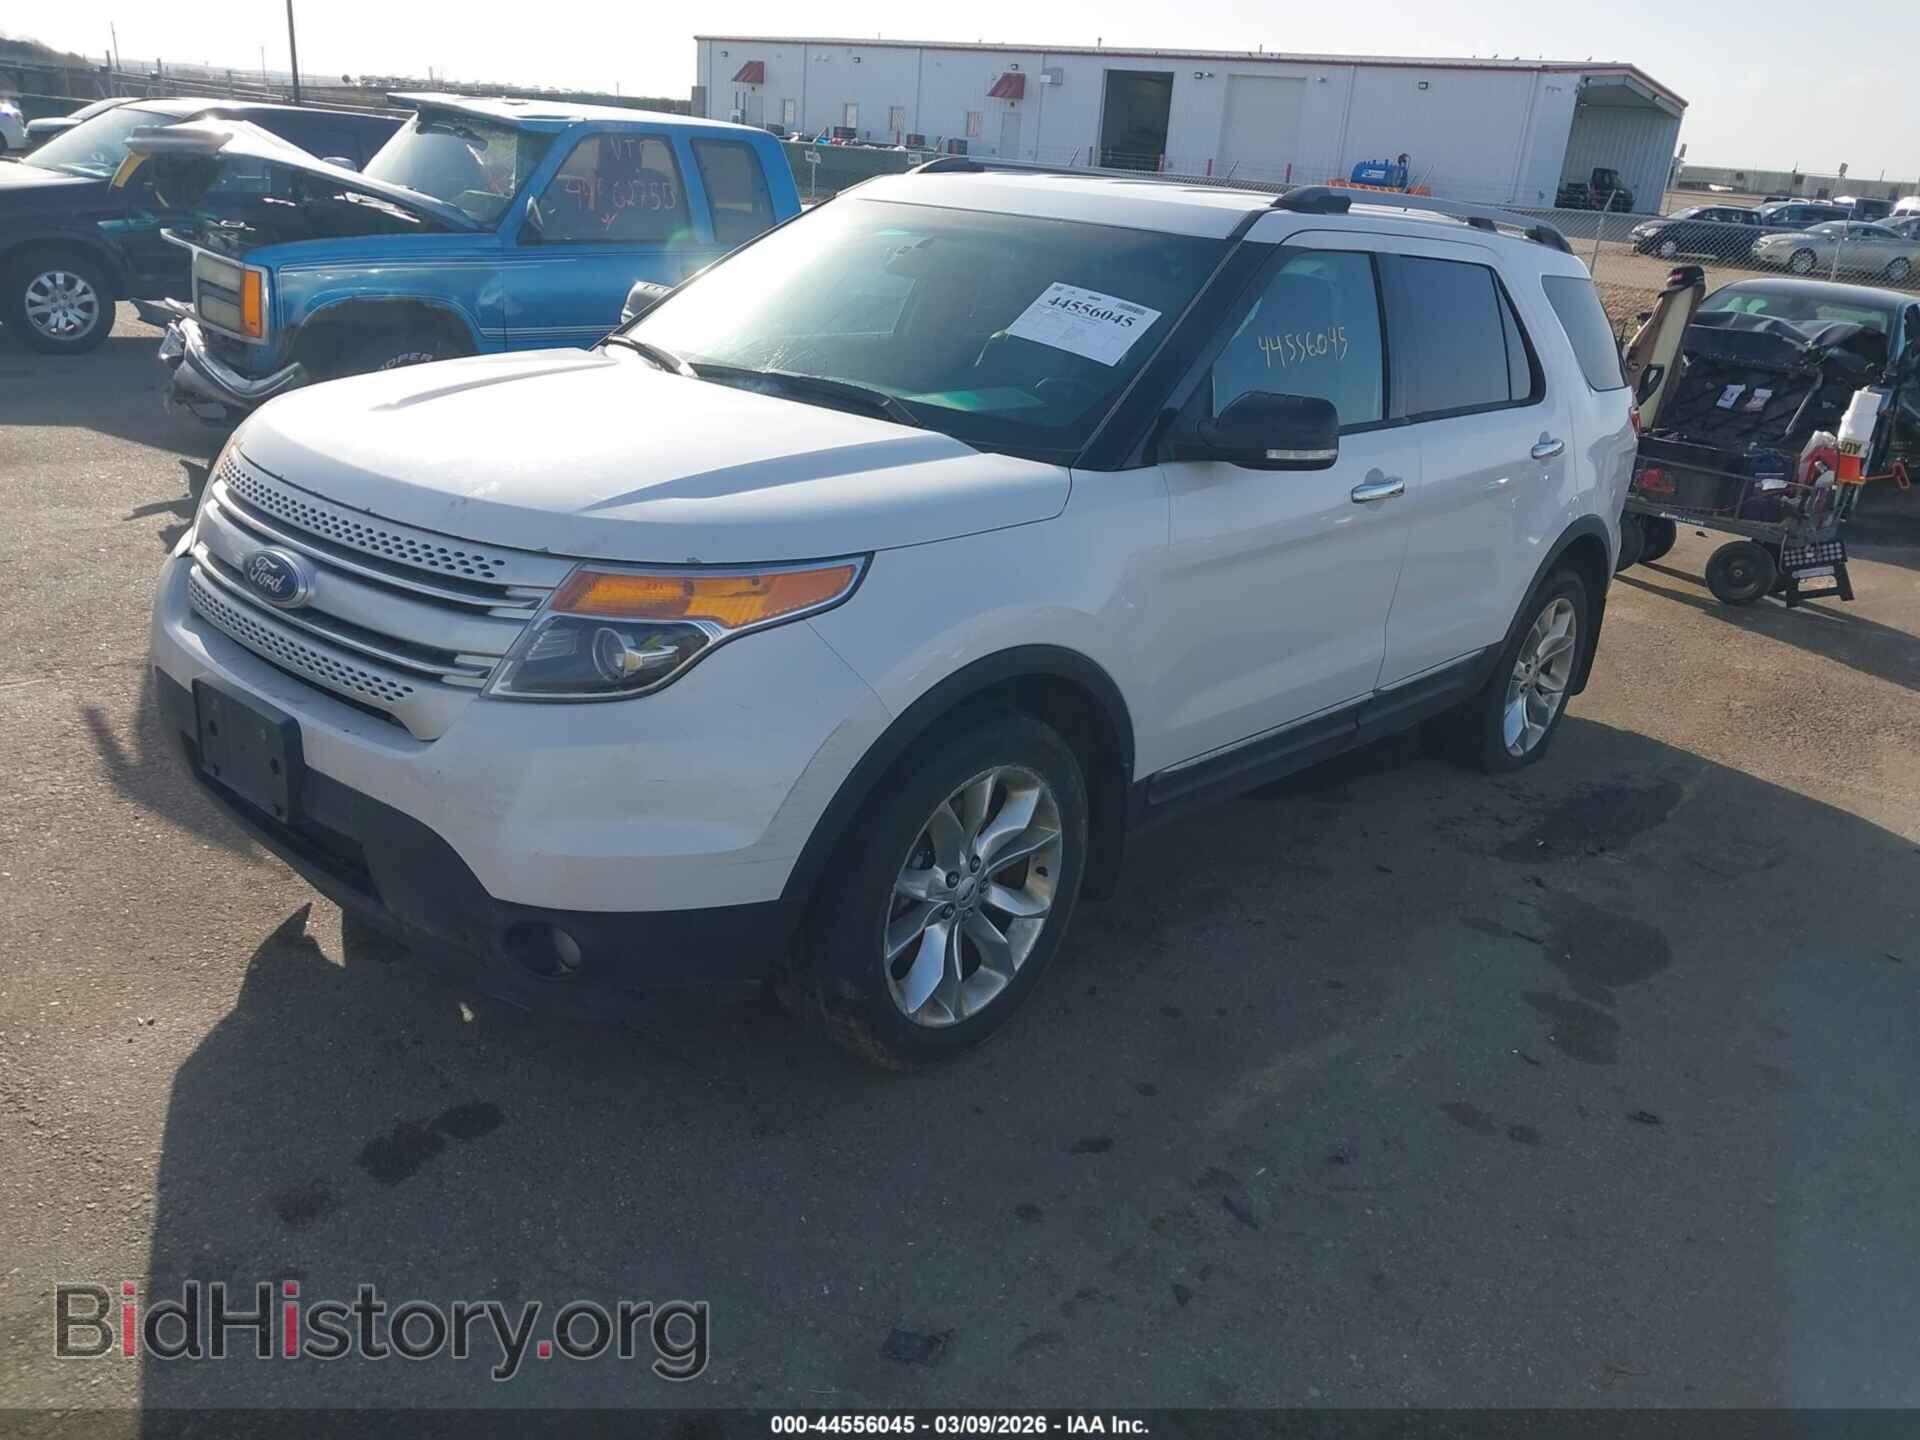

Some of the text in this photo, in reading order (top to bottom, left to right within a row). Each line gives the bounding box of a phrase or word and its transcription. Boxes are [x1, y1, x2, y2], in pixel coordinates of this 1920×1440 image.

[1047, 296, 1137, 329] 44556045
[1257, 326, 1348, 369] 44556045
[250, 556, 286, 593] Ford
